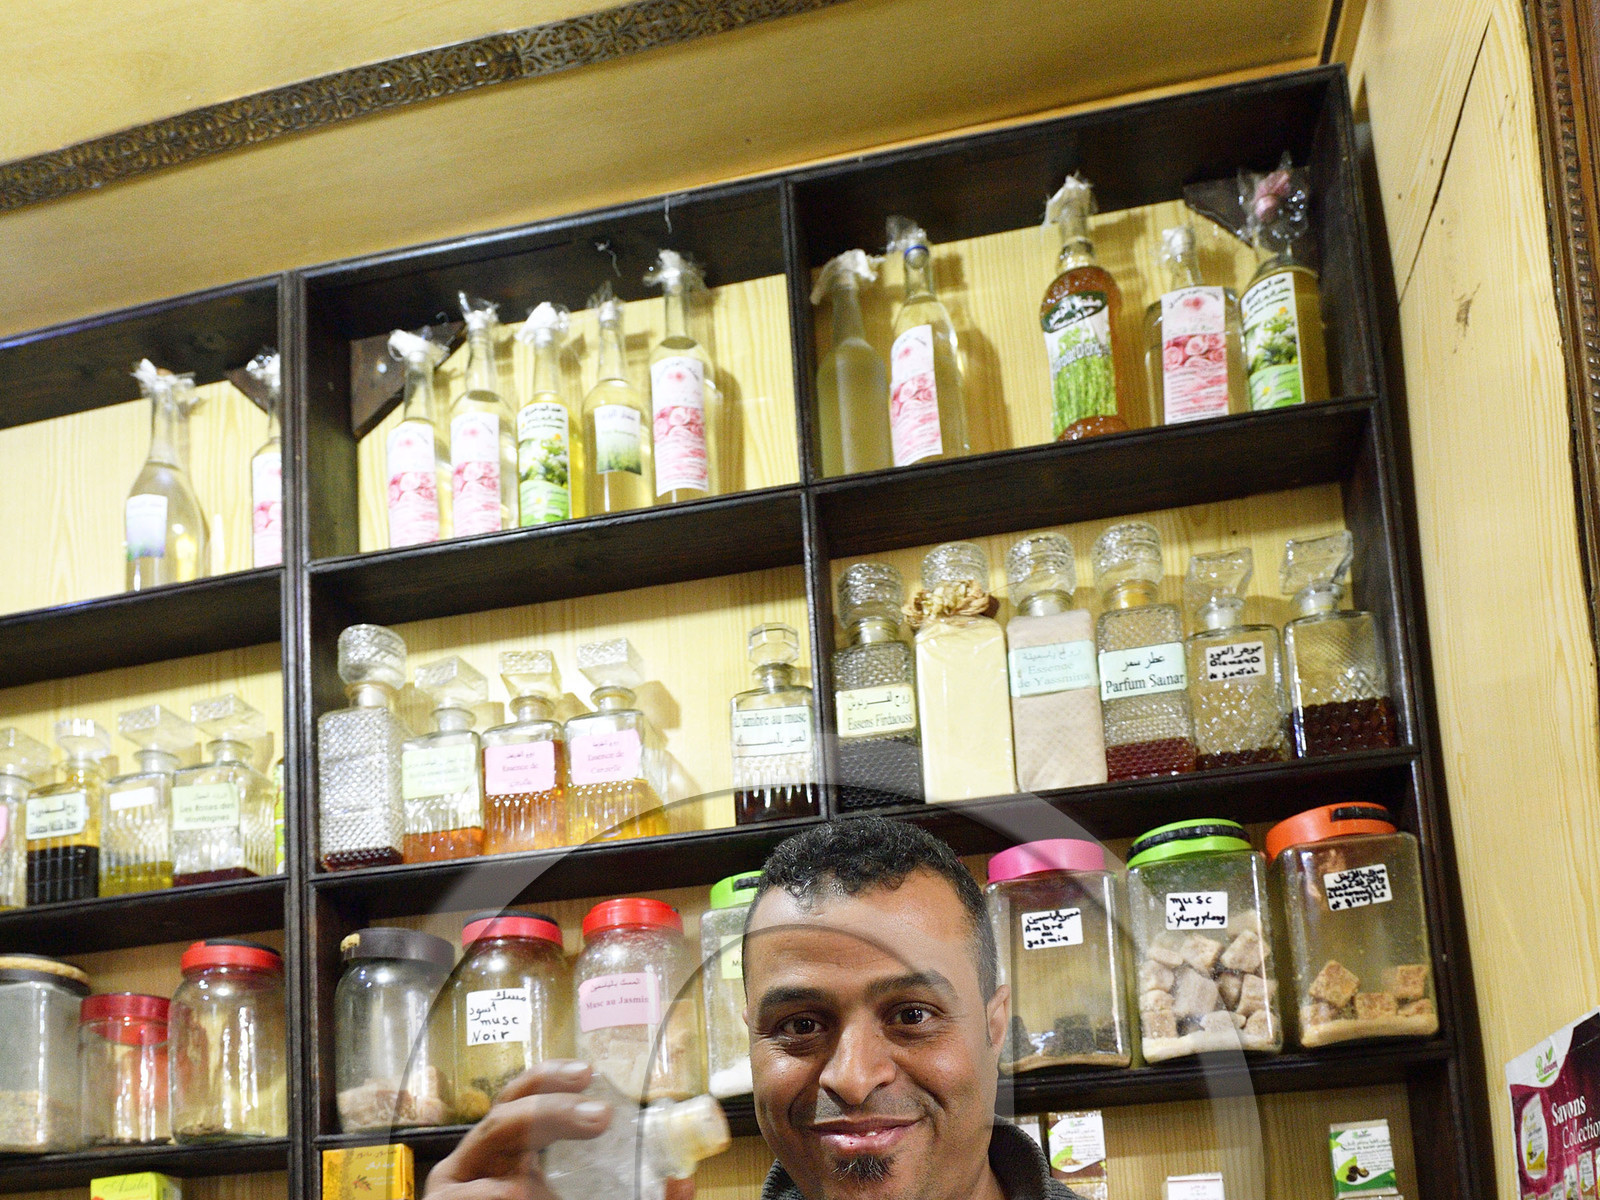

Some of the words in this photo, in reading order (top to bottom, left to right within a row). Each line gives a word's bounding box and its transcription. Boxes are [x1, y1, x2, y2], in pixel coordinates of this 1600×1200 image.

[1144, 651, 1165, 669] عطر
[1028, 663, 1073, 675] Essence
[1018, 680, 1030, 688] de
[1105, 677, 1146, 693] Parfum
[1025, 923, 1063, 933] Ambre
[586, 1000, 603, 1010] Musc
[618, 995, 649, 1005] Jasmin
[480, 1015, 520, 1026] musc
[472, 1029, 510, 1043] Noir
[1551, 1095, 1587, 1127] Savons
[1561, 1117, 1600, 1149] Collectio
